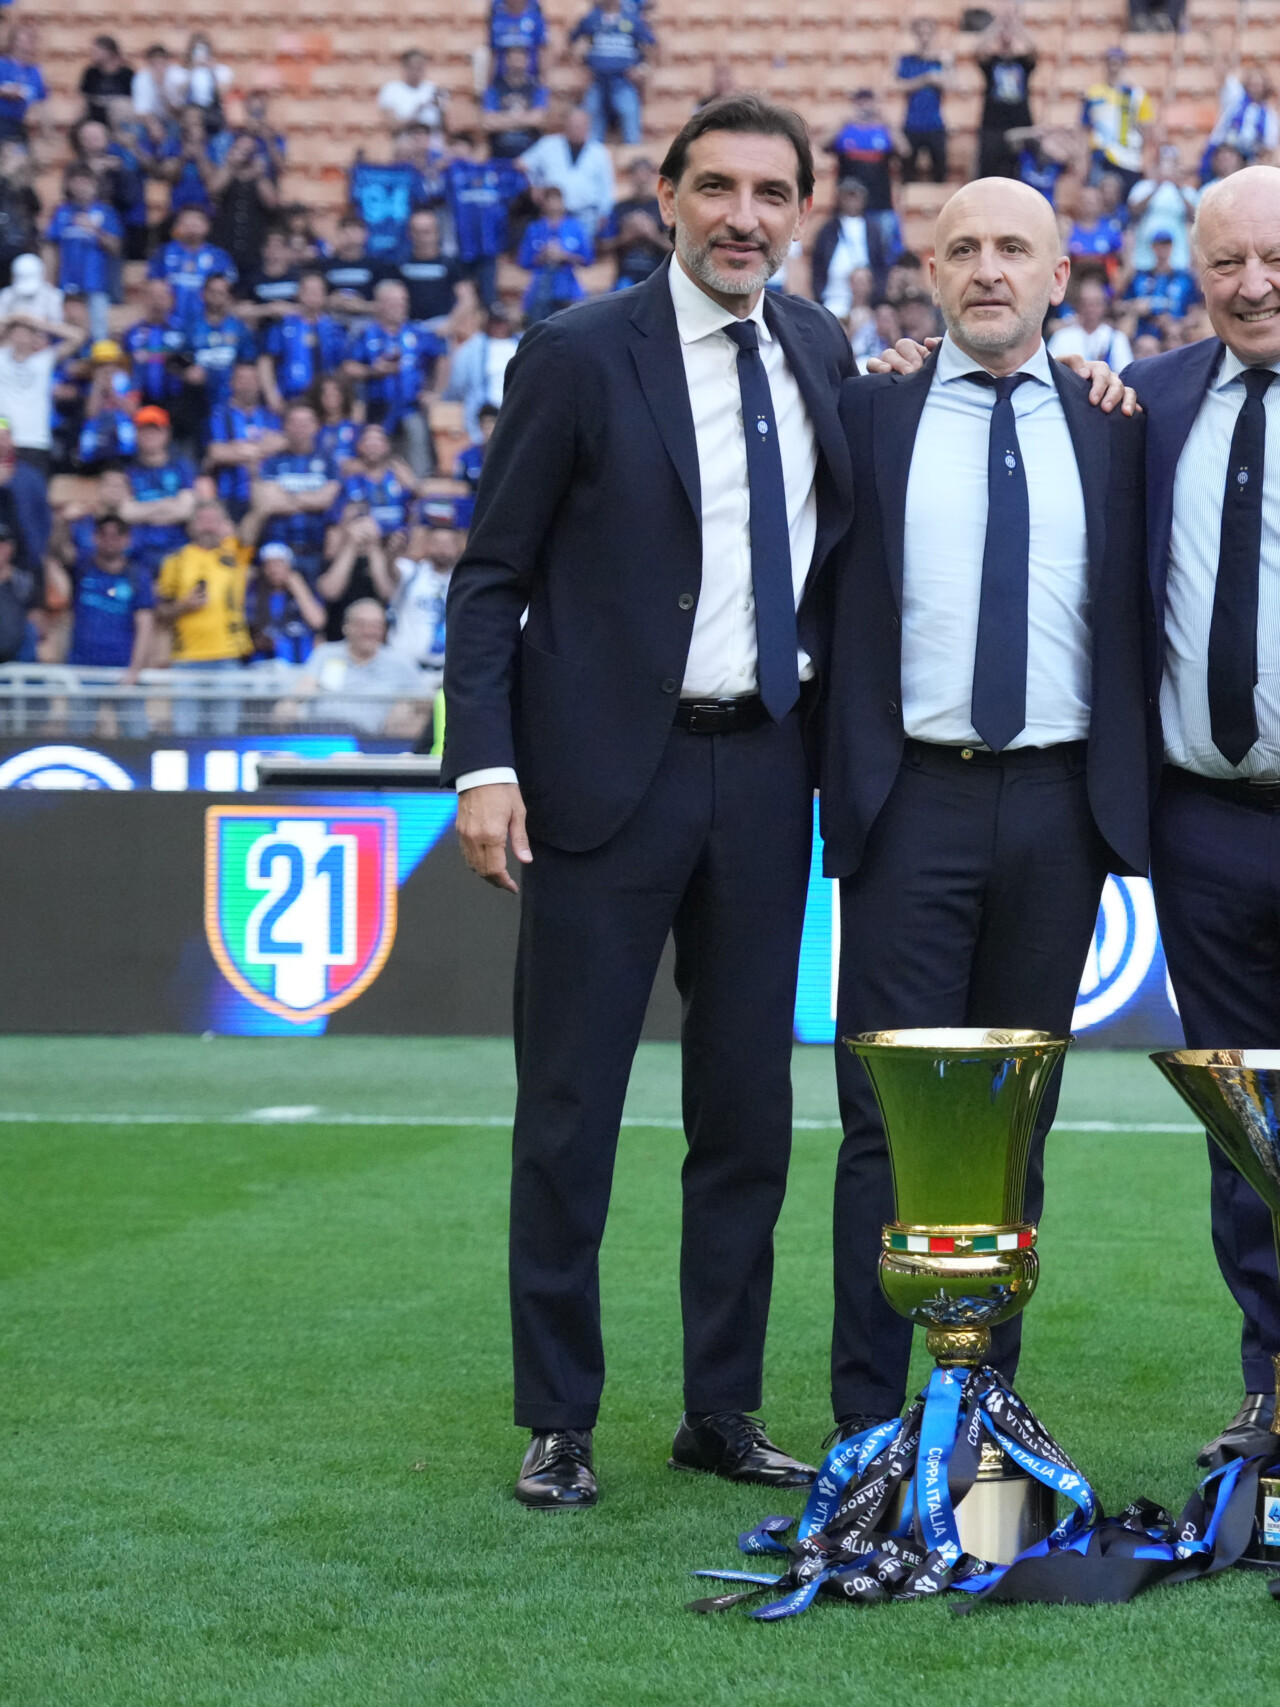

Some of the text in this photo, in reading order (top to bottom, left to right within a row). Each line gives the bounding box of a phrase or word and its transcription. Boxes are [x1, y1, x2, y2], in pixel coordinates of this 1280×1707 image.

[255, 838, 349, 958] 21
[925, 1447, 947, 1538] COPPA ITALIA
[1013, 1449, 1056, 1479] ITALIA
[902, 1551, 923, 1566] FRE
